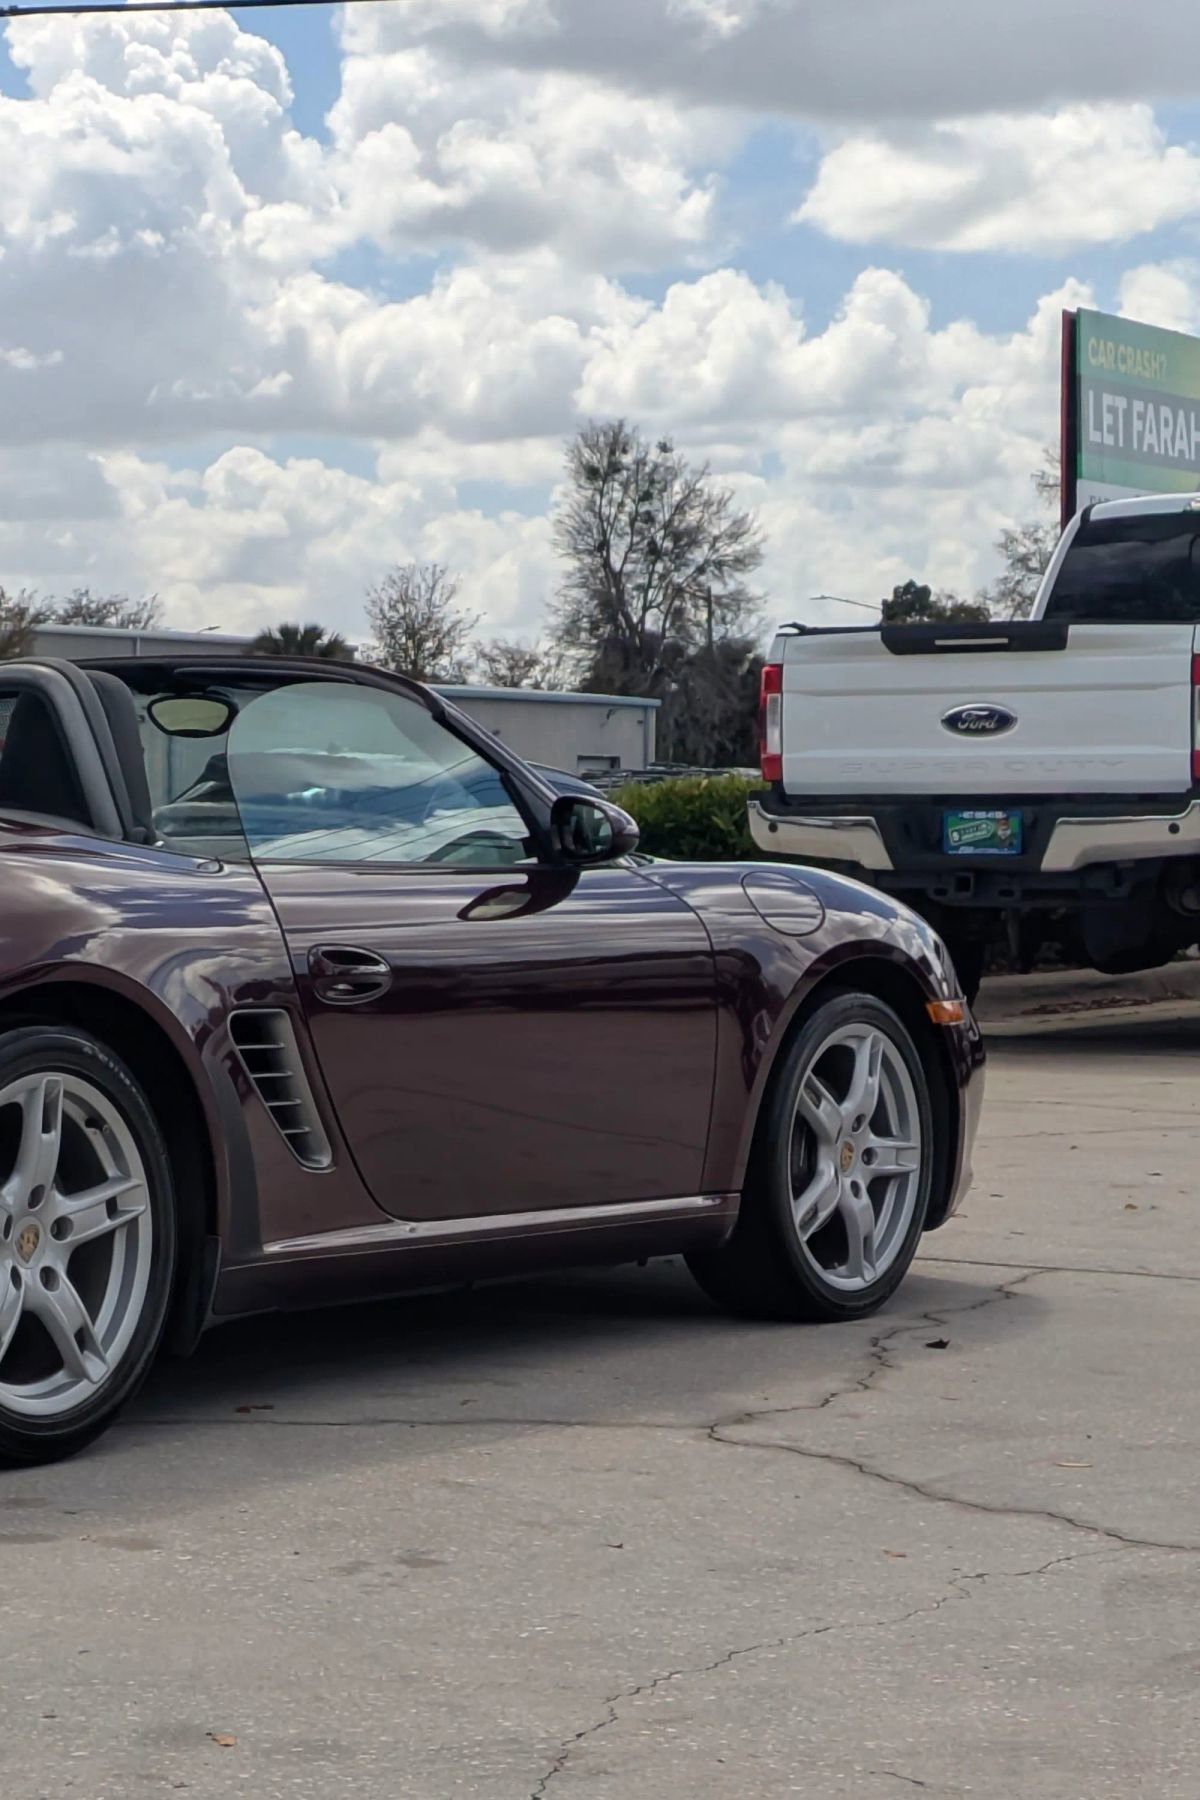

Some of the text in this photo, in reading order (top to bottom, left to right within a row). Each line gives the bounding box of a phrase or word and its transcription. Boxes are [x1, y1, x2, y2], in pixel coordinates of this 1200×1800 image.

[1088, 336, 1167, 381] CAR CRASH?
[1088, 389, 1200, 461] LET FARAH
[957, 710, 999, 729] Ford
[839, 759, 1129, 775] SUPER DUTY
